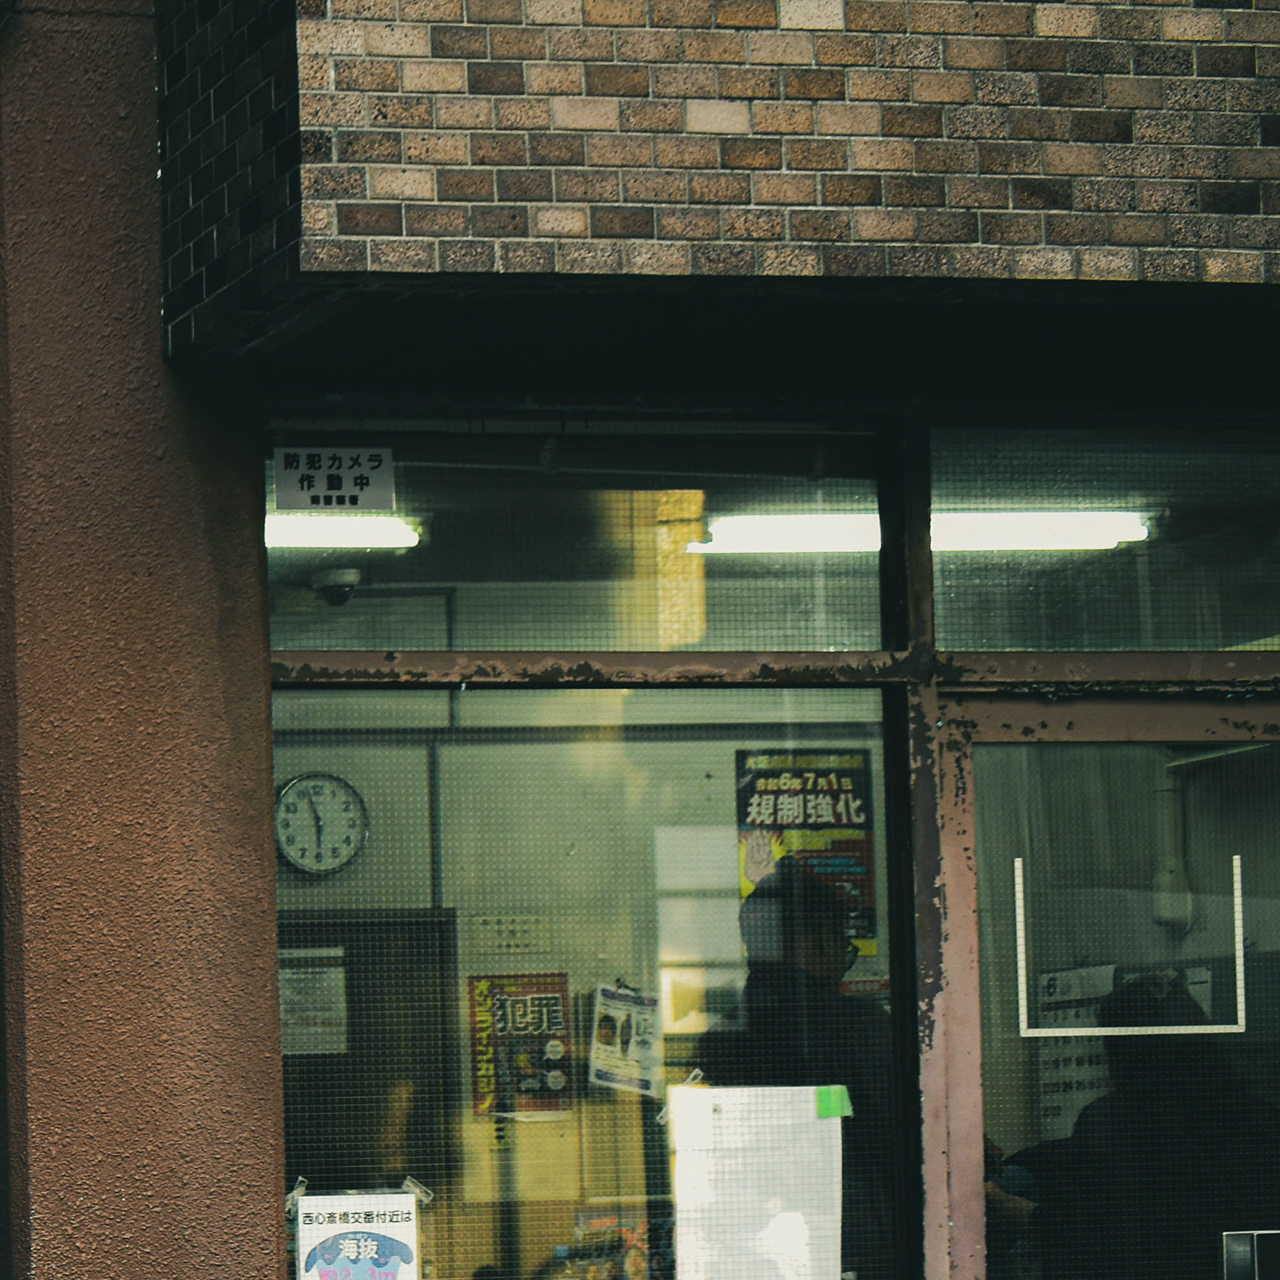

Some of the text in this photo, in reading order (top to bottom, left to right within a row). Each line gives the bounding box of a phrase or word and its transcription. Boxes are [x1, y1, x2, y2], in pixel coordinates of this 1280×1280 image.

[283, 452, 383, 471] 防犯カメラ
[298, 473, 371, 491] 作動中
[745, 793, 867, 825] 規制強化
[493, 994, 567, 1036] 犯罪
[301, 1209, 413, 1225] 西心斎橋交番付近は
[338, 1238, 380, 1260] 海抜
